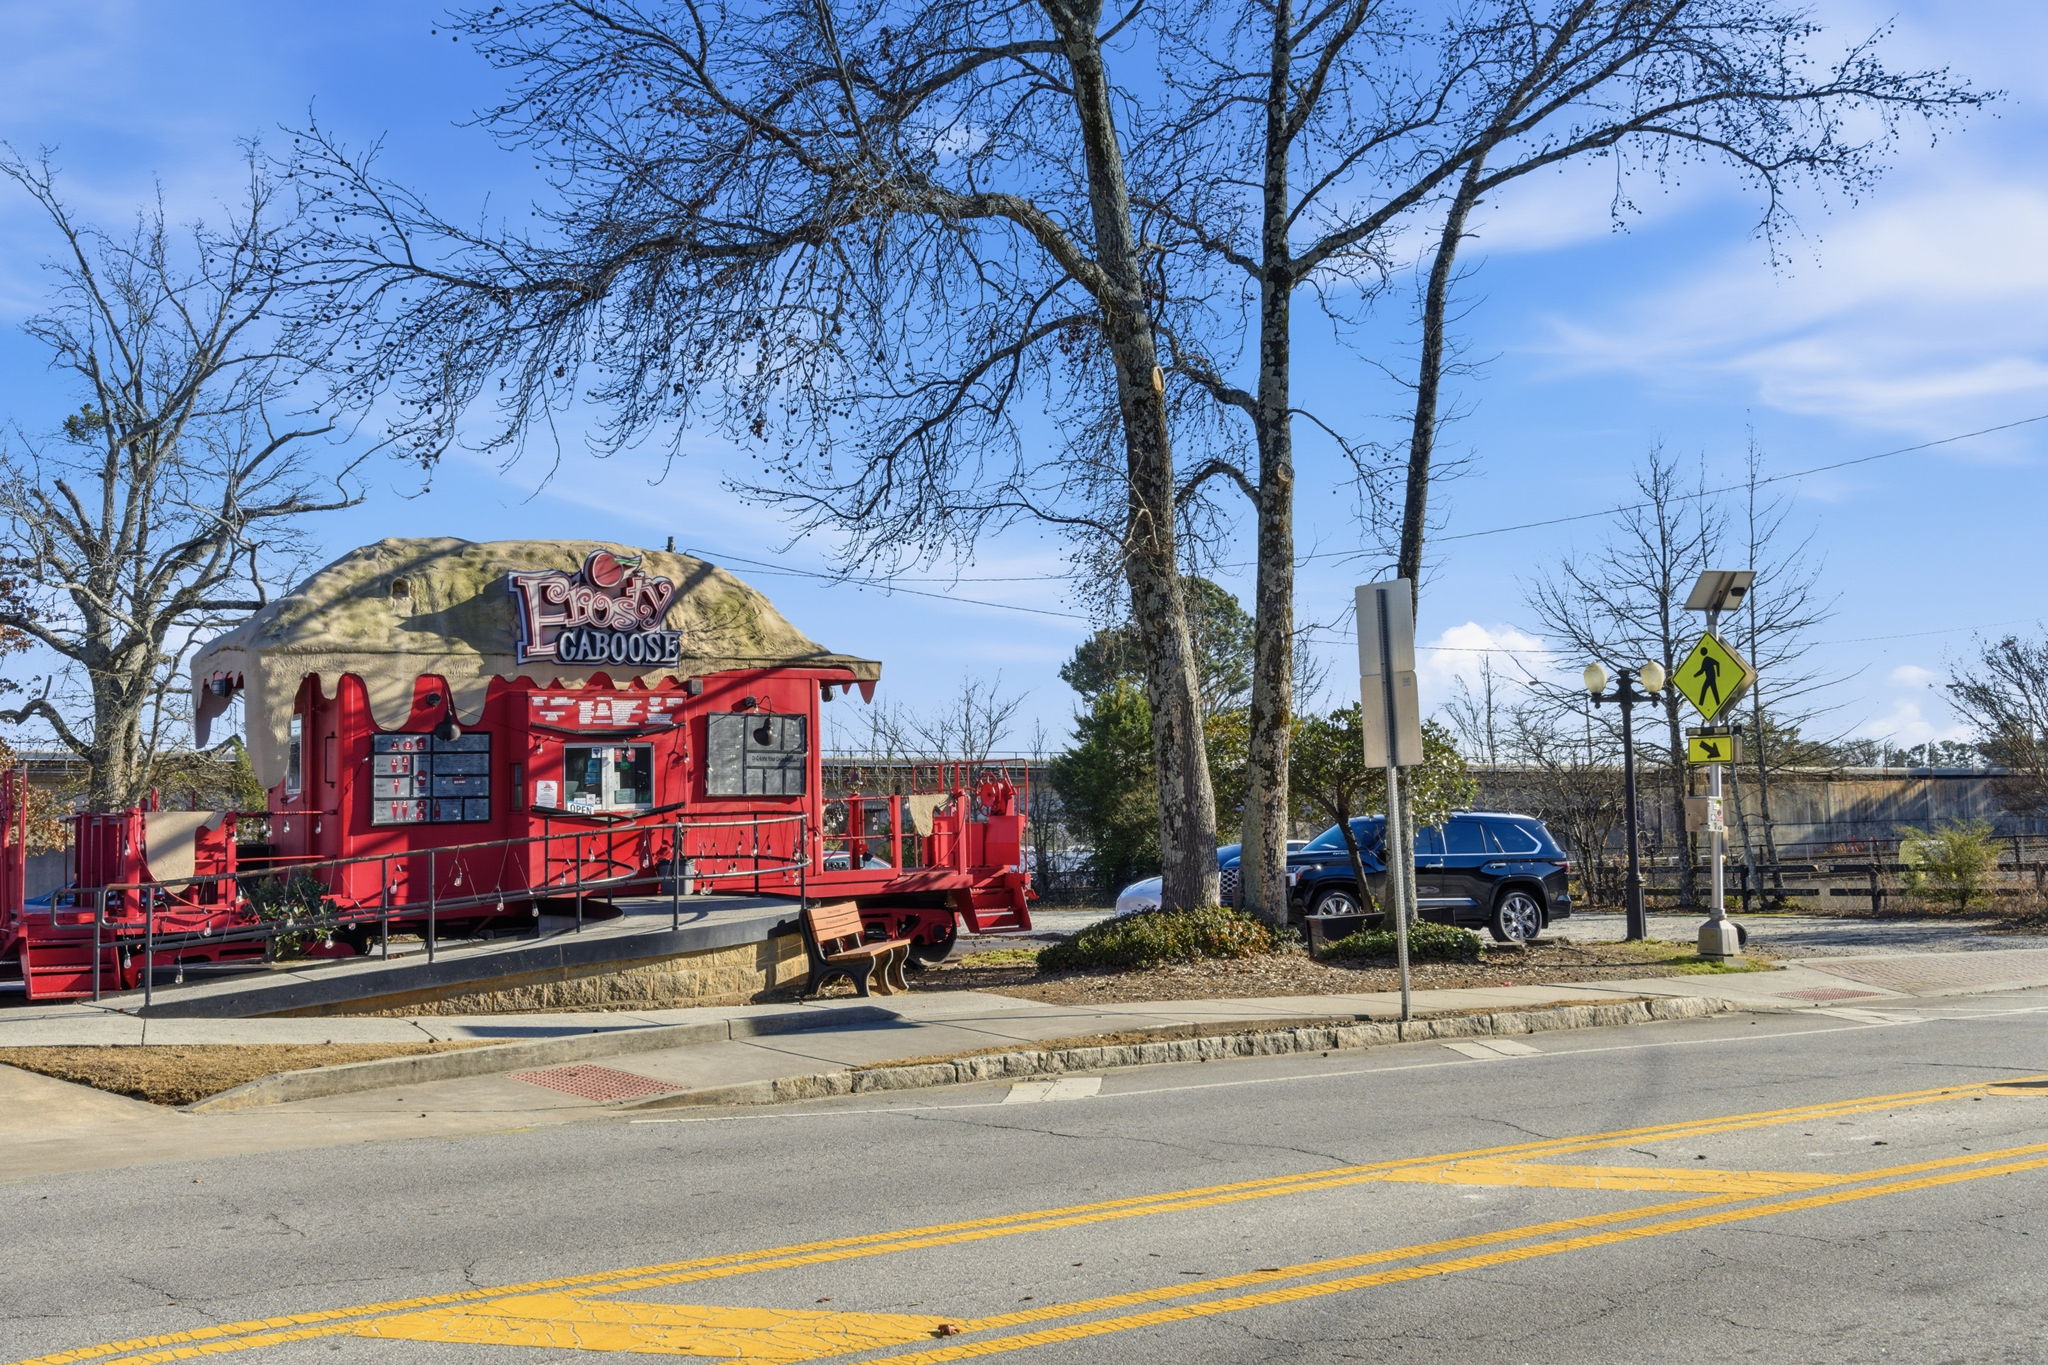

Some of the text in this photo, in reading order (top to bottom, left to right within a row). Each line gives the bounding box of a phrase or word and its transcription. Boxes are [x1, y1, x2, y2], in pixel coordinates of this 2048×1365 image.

[515, 575, 676, 656] Frosty
[558, 631, 680, 662] CABOOSE
[570, 804, 592, 815] OPEN
